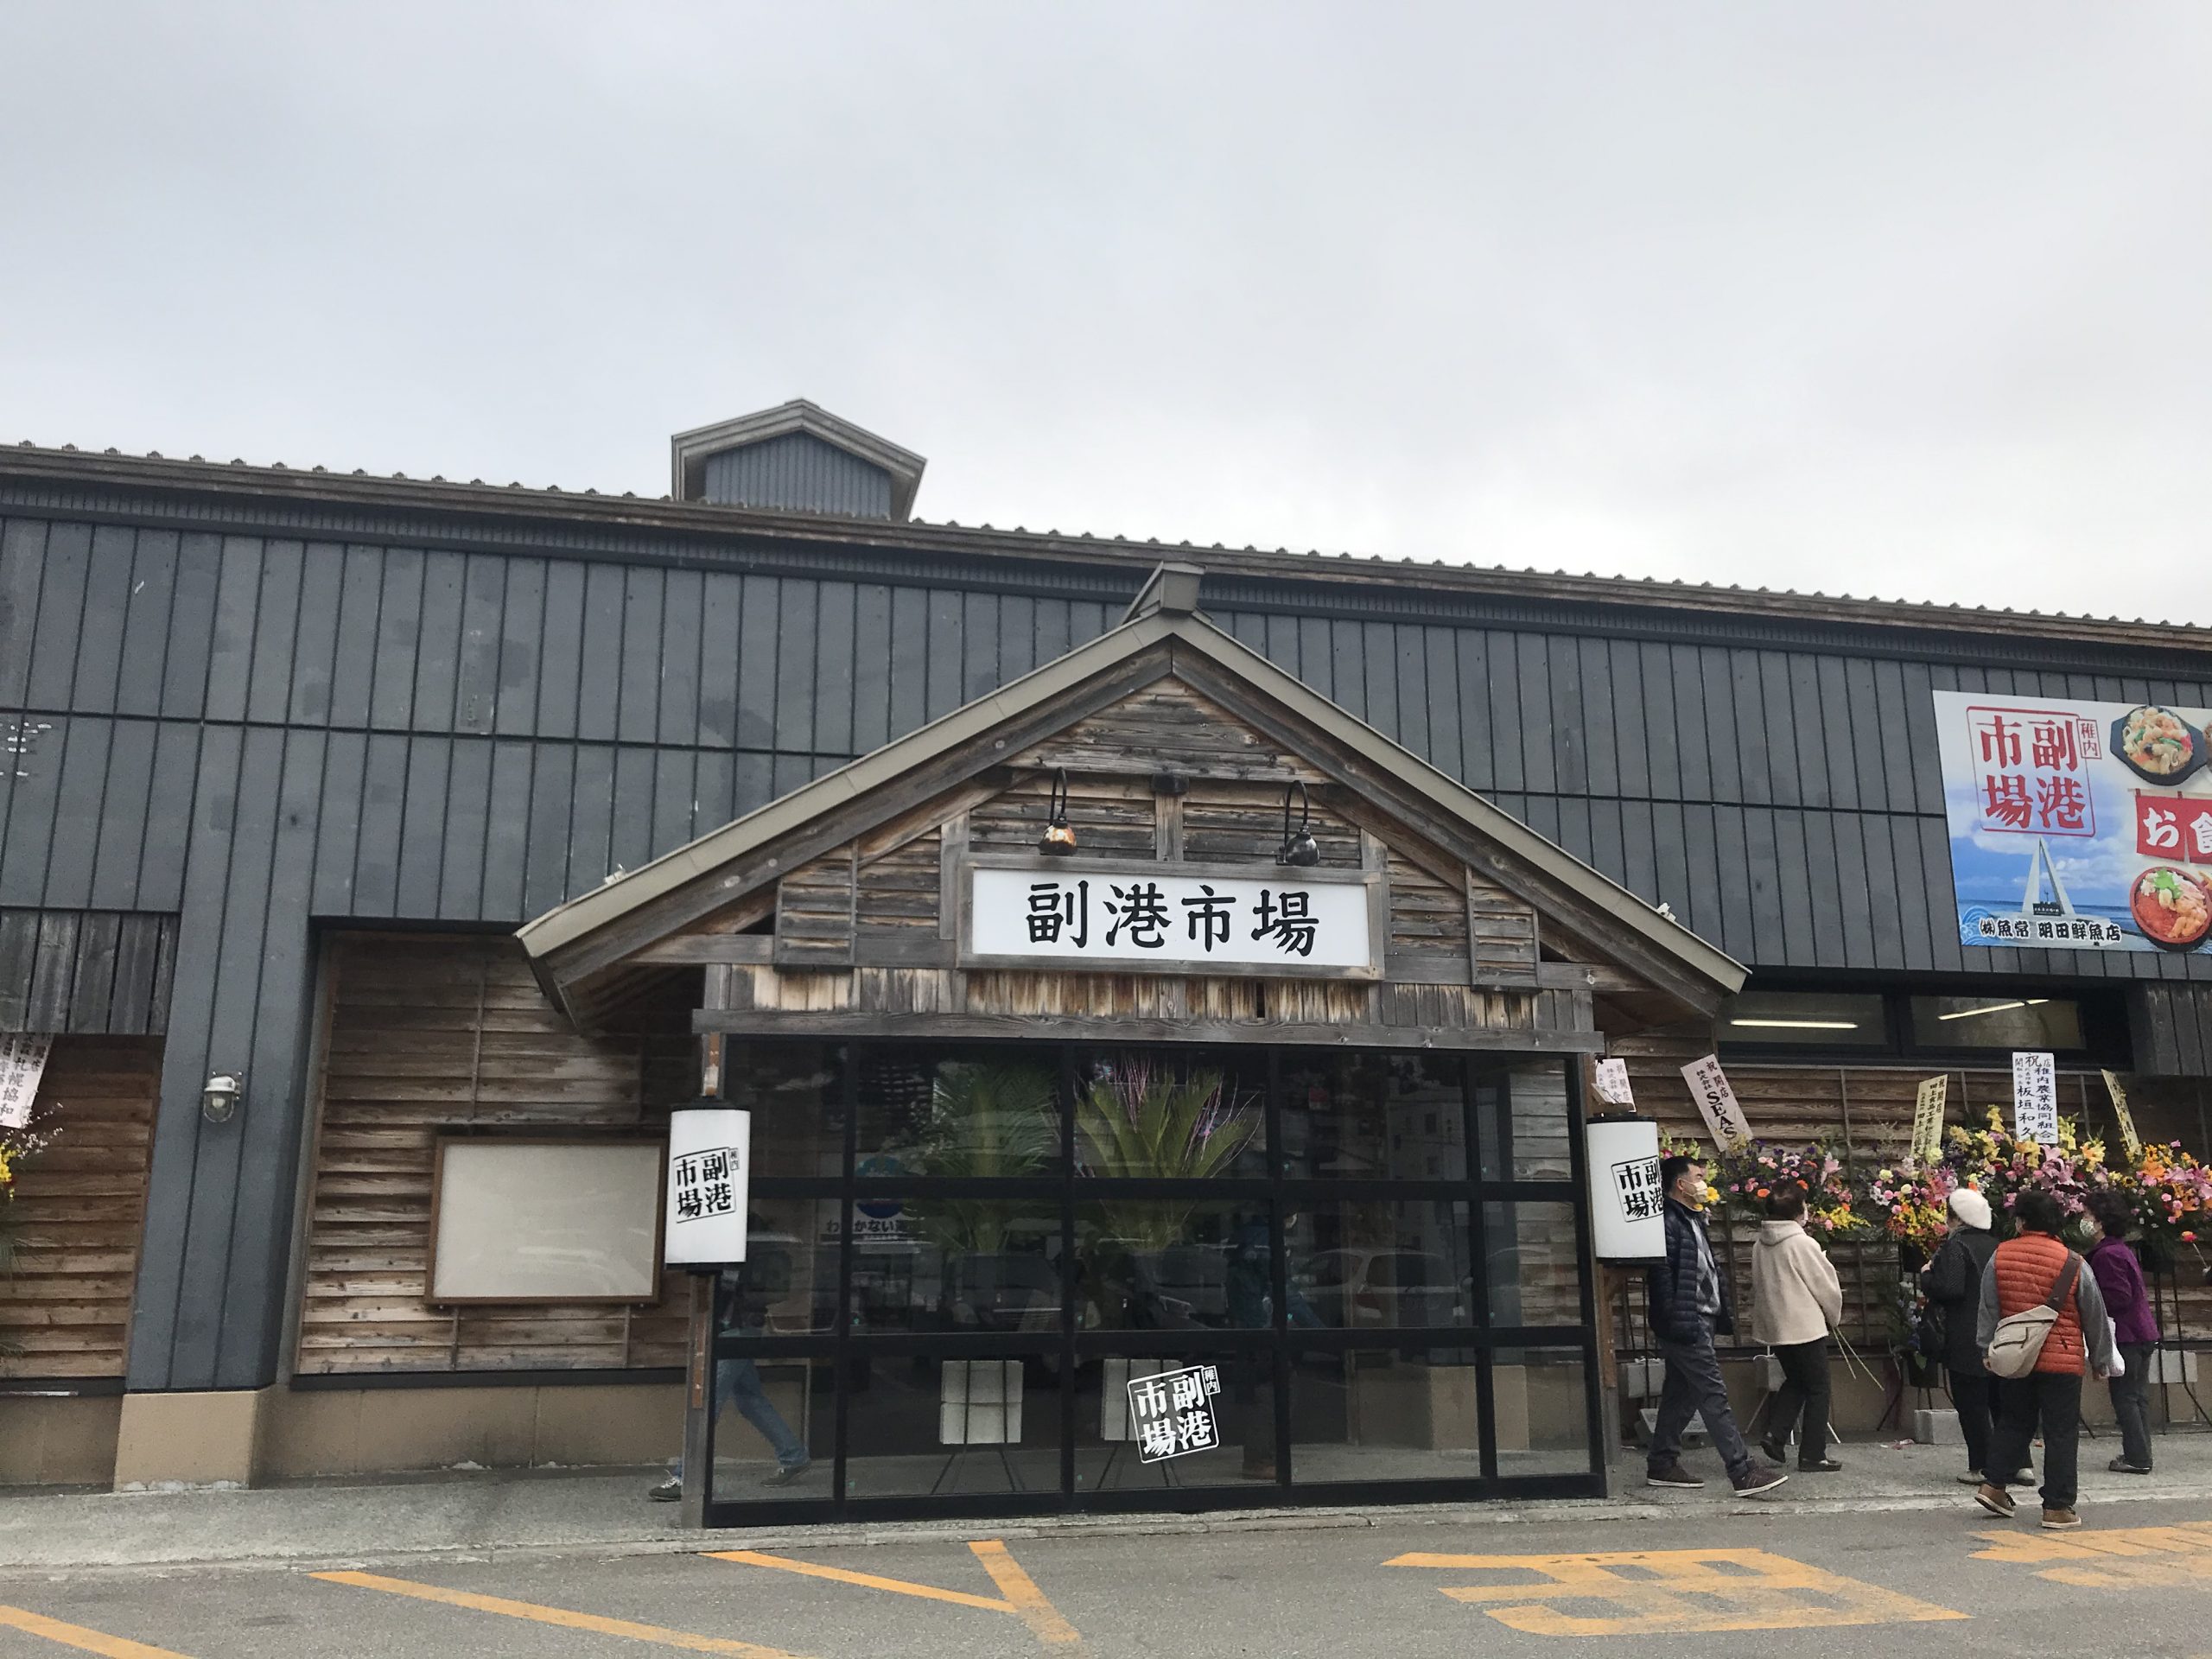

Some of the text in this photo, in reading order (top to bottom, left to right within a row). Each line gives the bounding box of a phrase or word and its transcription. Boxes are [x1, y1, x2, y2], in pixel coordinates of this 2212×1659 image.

[1975, 715, 2033, 829] 市場
[2028, 719, 2086, 830] 副港
[2079, 722, 2099, 757] 稚内
[1025, 880, 1319, 957] 副港市場
